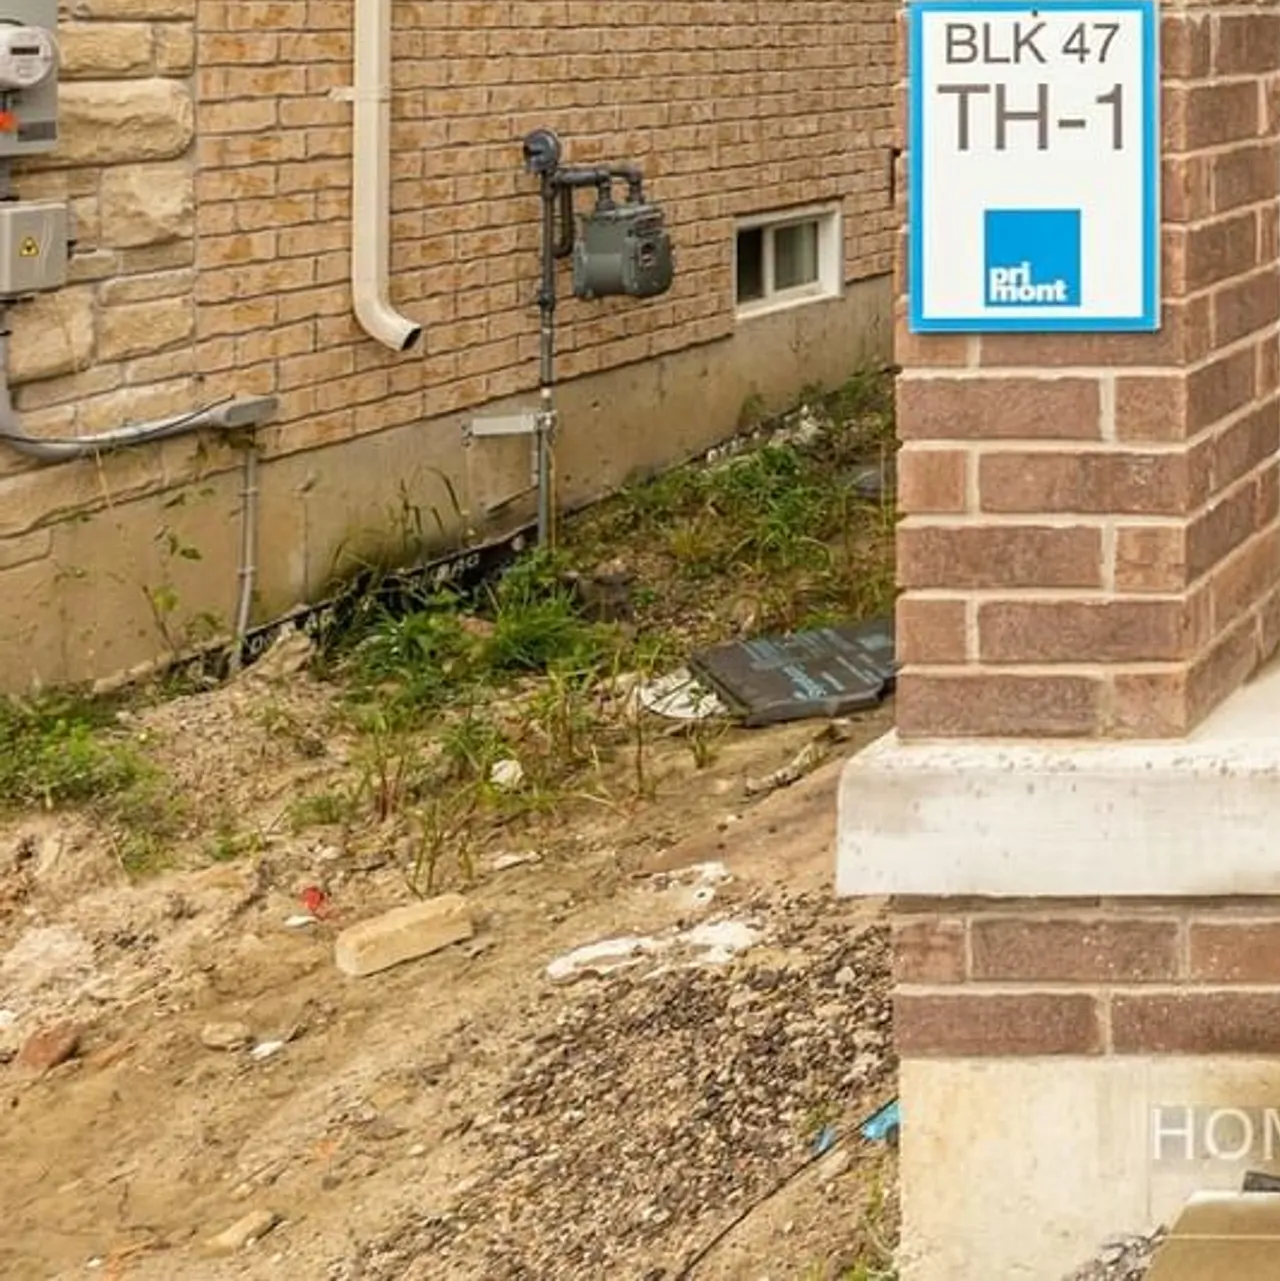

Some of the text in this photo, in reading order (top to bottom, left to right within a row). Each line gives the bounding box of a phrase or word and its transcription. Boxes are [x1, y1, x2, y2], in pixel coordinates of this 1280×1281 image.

[945, 21, 1120, 65] BLK 47
[936, 82, 1124, 152] TH-1
[990, 261, 1030, 287] pri
[990, 280, 1069, 302] mont
